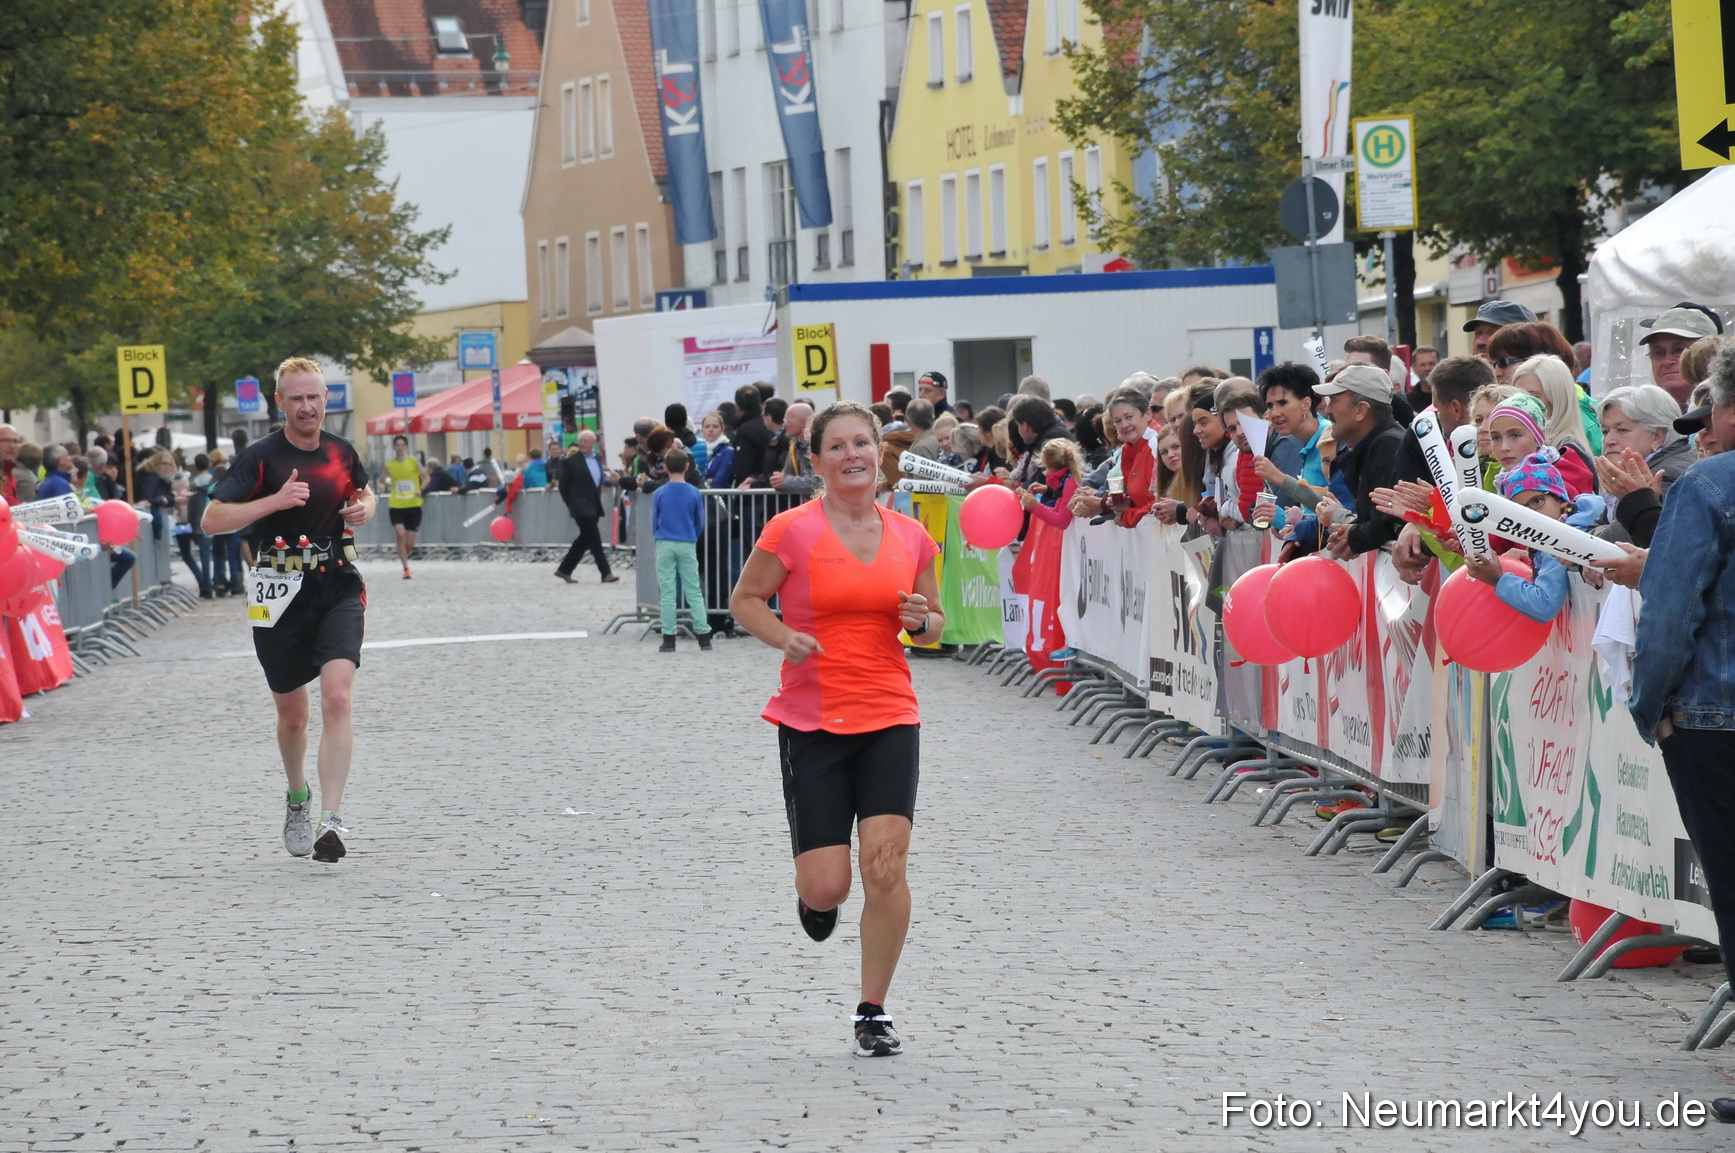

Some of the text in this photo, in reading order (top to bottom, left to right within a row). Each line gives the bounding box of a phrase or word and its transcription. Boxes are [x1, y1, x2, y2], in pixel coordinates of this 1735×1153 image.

[772, 24, 817, 116] K&L
[661, 49, 700, 137] K&L
[946, 125, 976, 161] HOTEL
[1315, 161, 1338, 171] Ulmer
[796, 326, 832, 340] Block
[124, 350, 159, 361] Block
[805, 345, 827, 375] D
[704, 363, 751, 375] DAHMIT
[131, 367, 154, 398] D
[240, 402, 260, 410] TAXI
[395, 396, 416, 405] TAXI
[919, 467, 941, 481] BMW
[920, 485, 942, 493] BMW
[1496, 517, 1550, 546] BMW
[256, 582, 289, 603] 342
